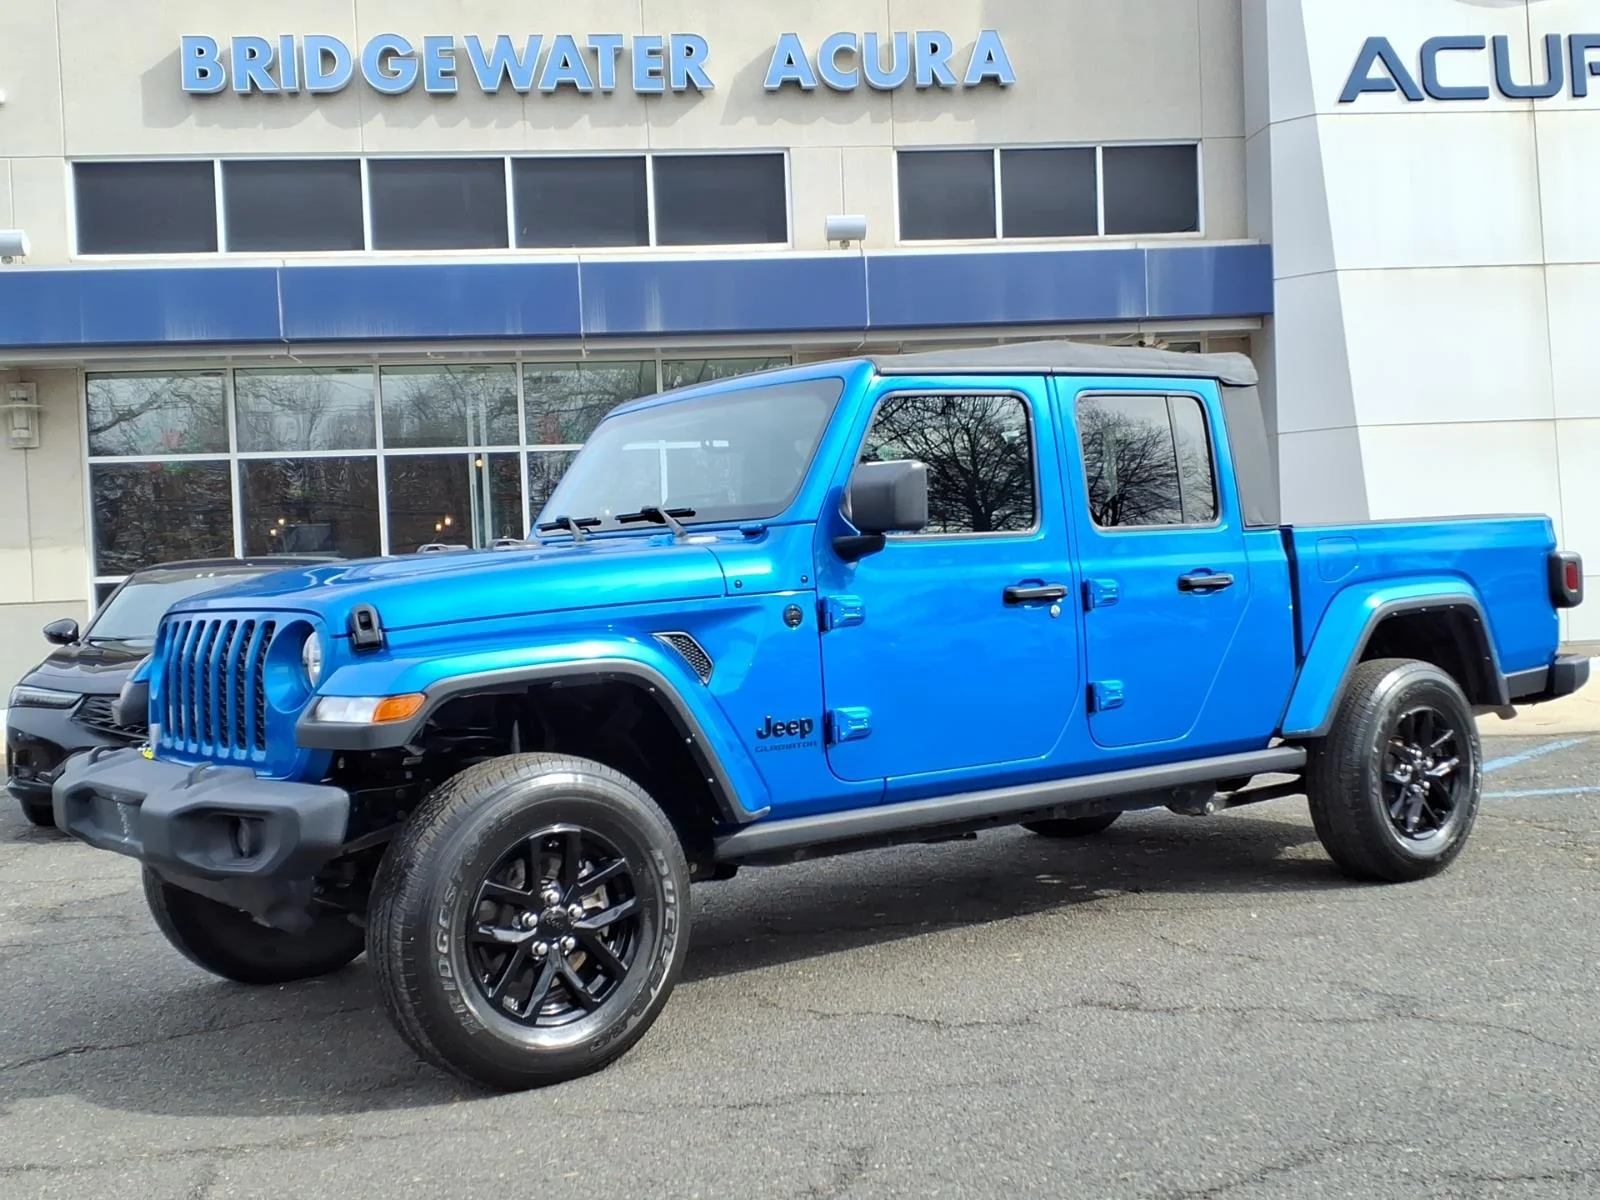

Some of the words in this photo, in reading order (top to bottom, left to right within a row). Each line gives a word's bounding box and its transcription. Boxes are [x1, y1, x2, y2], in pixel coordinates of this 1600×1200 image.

[180, 33, 715, 97] BRIDGEWATER
[763, 29, 1017, 92] ACURA
[755, 715, 814, 740] Jeep
[754, 740, 818, 753] GLADIATOR
